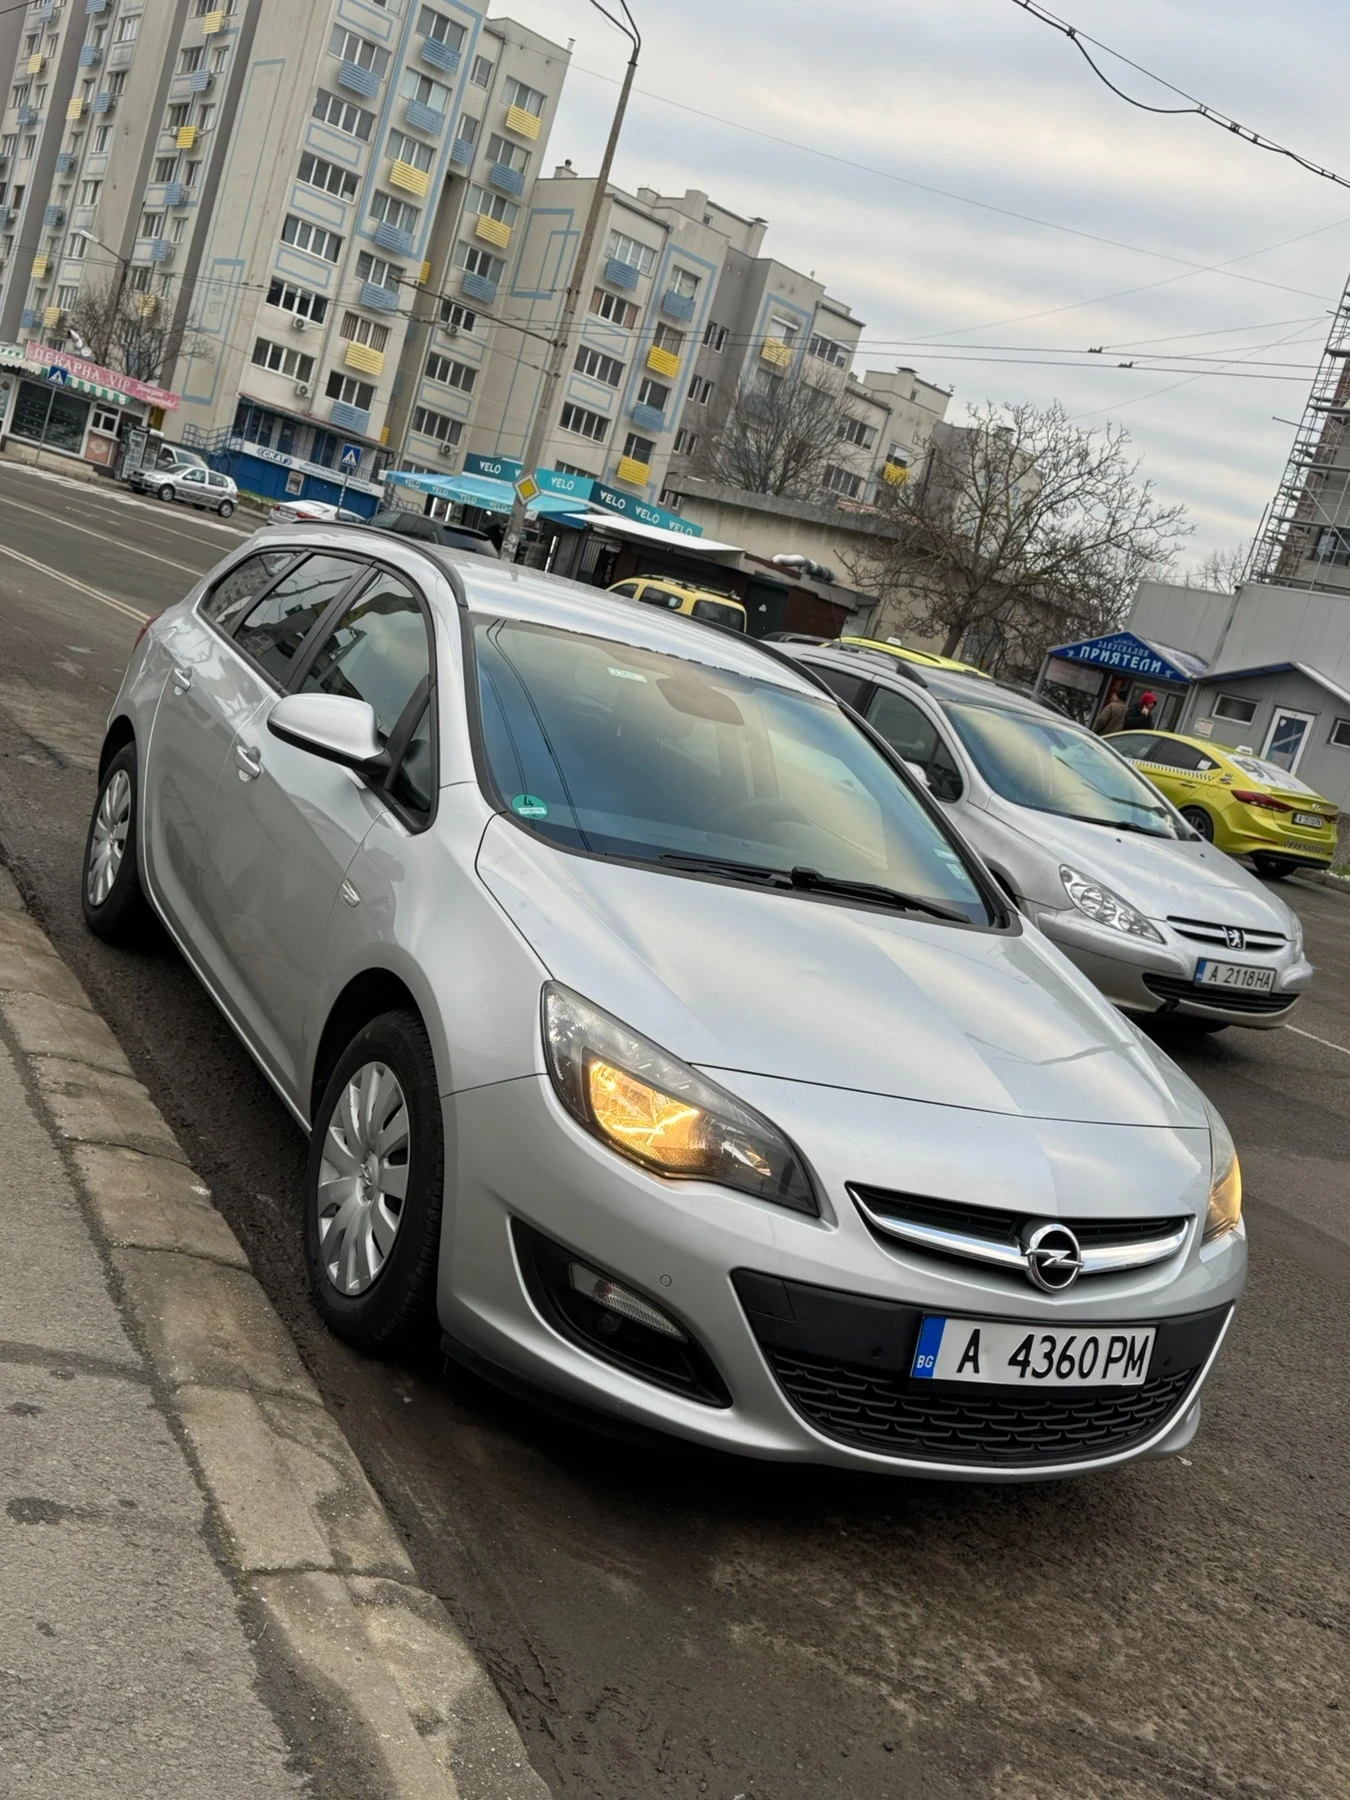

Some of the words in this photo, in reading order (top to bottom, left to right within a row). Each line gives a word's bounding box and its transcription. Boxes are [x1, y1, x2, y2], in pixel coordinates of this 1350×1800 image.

[34, 347, 101, 381] ПЕКАРНА
[109, 375, 131, 391] VIP
[262, 449, 287, 464] СКАТ
[479, 461, 502, 474] VELO
[405, 479, 421, 489] VELO
[432, 486, 449, 497] VELO
[551, 477, 575, 491] VELO
[460, 493, 477, 504] VELO
[600, 490, 626, 509] VELO
[635, 505, 660, 524] VELO
[669, 520, 693, 537] VELO
[1097, 640, 1149, 657] ЗАКУСВАЛНЯ
[1079, 646, 1162, 673] ПРИЯТЕЛИ
[1208, 965, 1219, 983] A
[1224, 967, 1272, 989] 2118HA
[916, 1354, 934, 1369] BG
[956, 1328, 981, 1374] A
[1008, 1333, 1150, 1379] 4360PM
